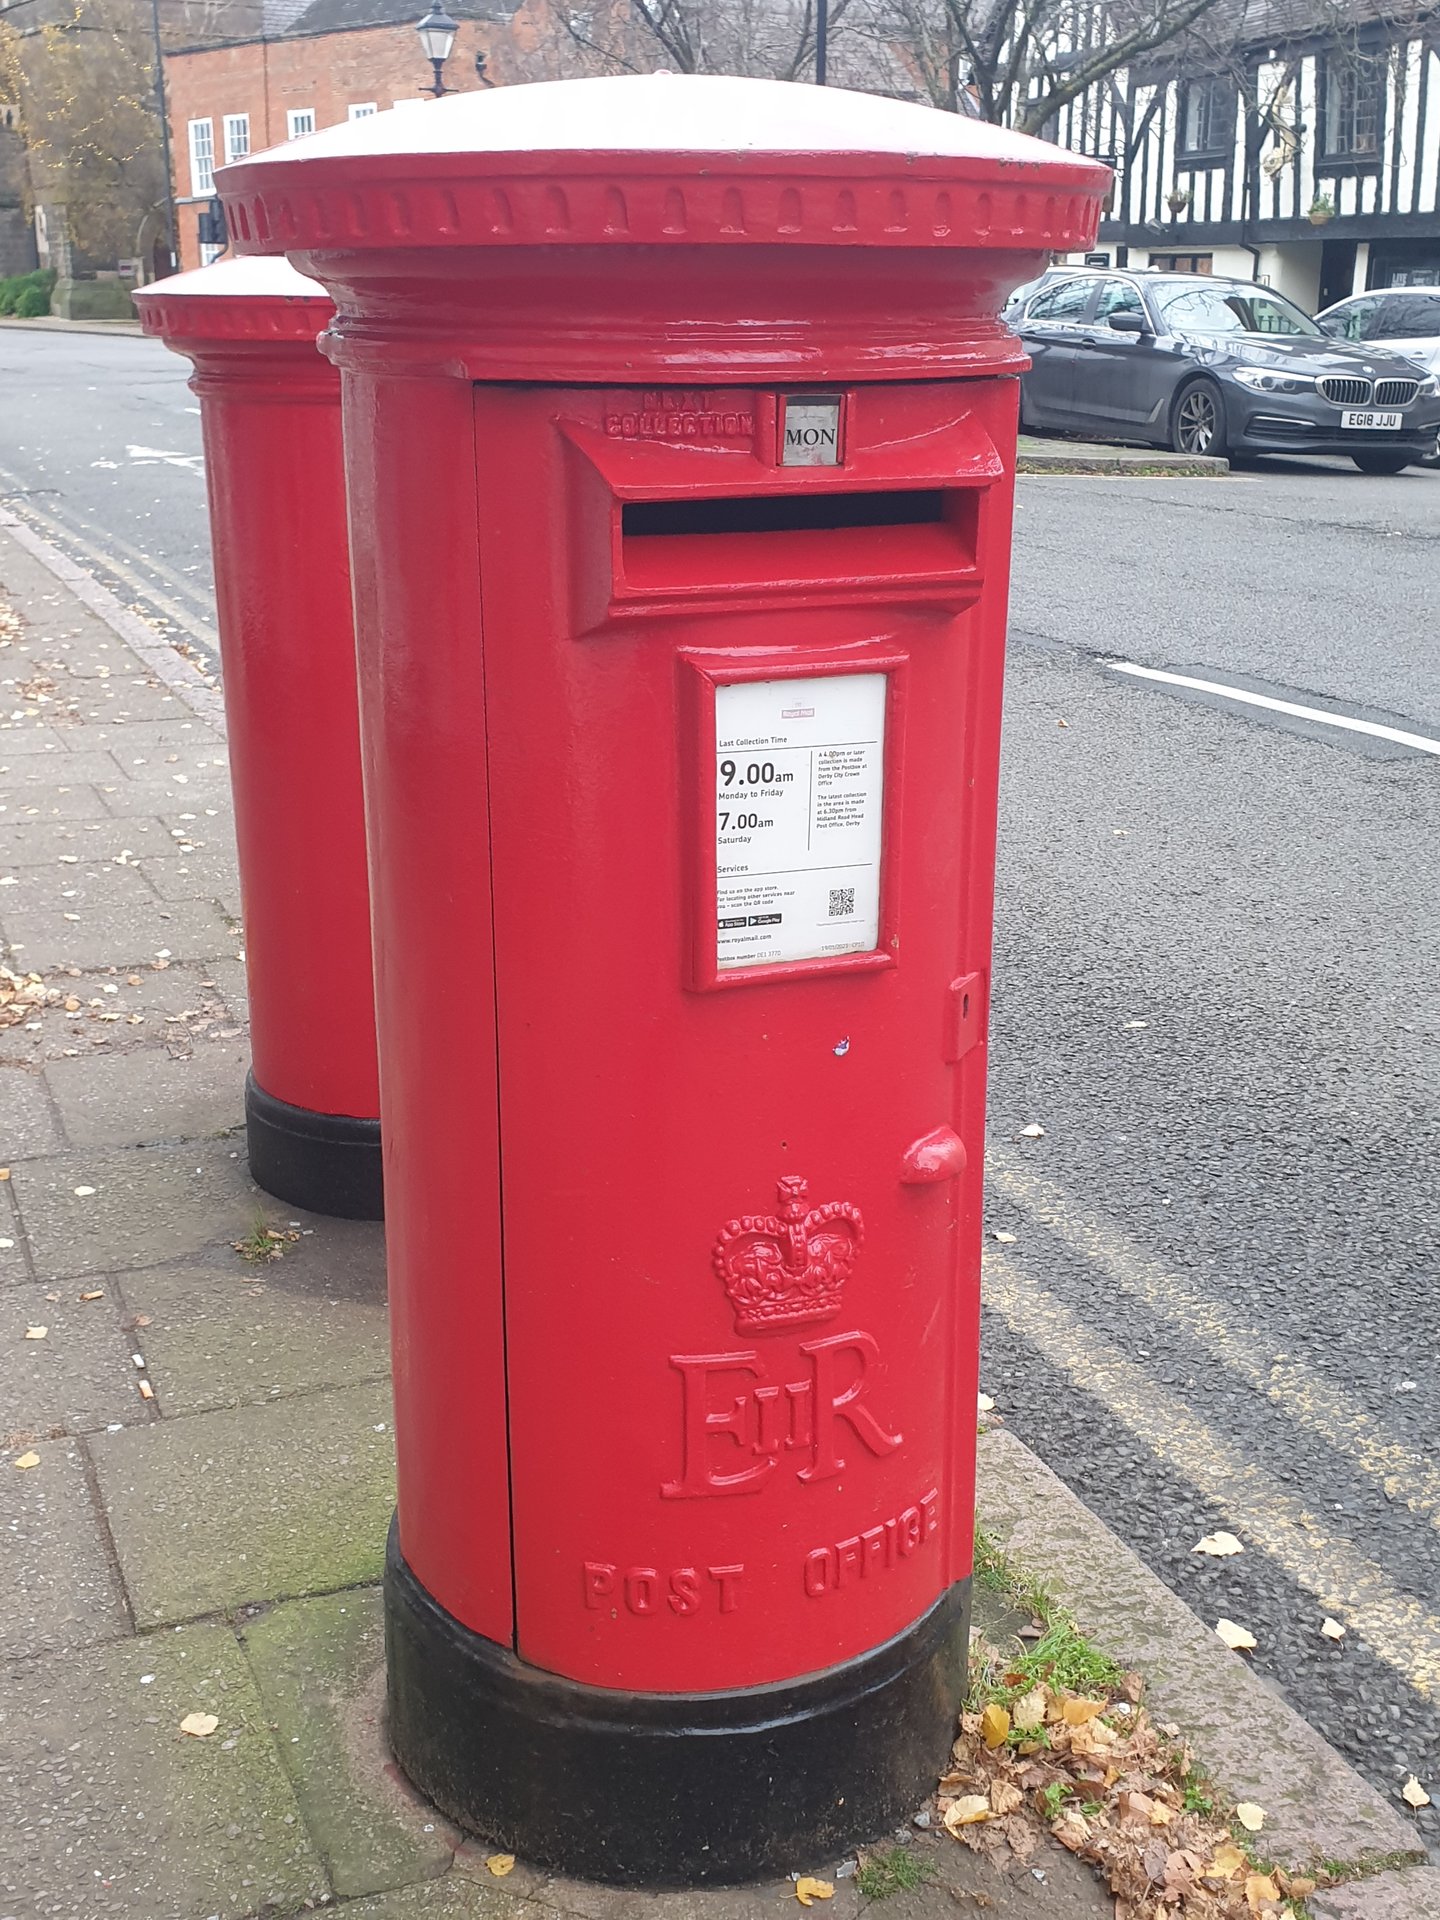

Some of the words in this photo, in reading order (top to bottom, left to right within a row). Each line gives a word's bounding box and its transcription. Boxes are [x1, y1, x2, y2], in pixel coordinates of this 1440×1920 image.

[606, 412, 754, 438] COLLECTION
[1349, 414, 1374, 426] EG18
[1376, 414, 1396, 427] JJU
[786, 428, 836, 446] MON
[736, 737, 769, 746] Collection
[771, 736, 788, 744] Time
[720, 760, 794, 786] 9.00am
[718, 791, 748, 800] Monday
[750, 790, 758, 798] to
[760, 789, 784, 798] Friday
[718, 812, 774, 831] 7.00am
[718, 836, 752, 845] Saturday
[717, 864, 749, 874] Services
[717, 934, 772, 944] www.royalmail.com
[584, 1560, 744, 1615] POST
[804, 1488, 938, 1598] OFFICE
